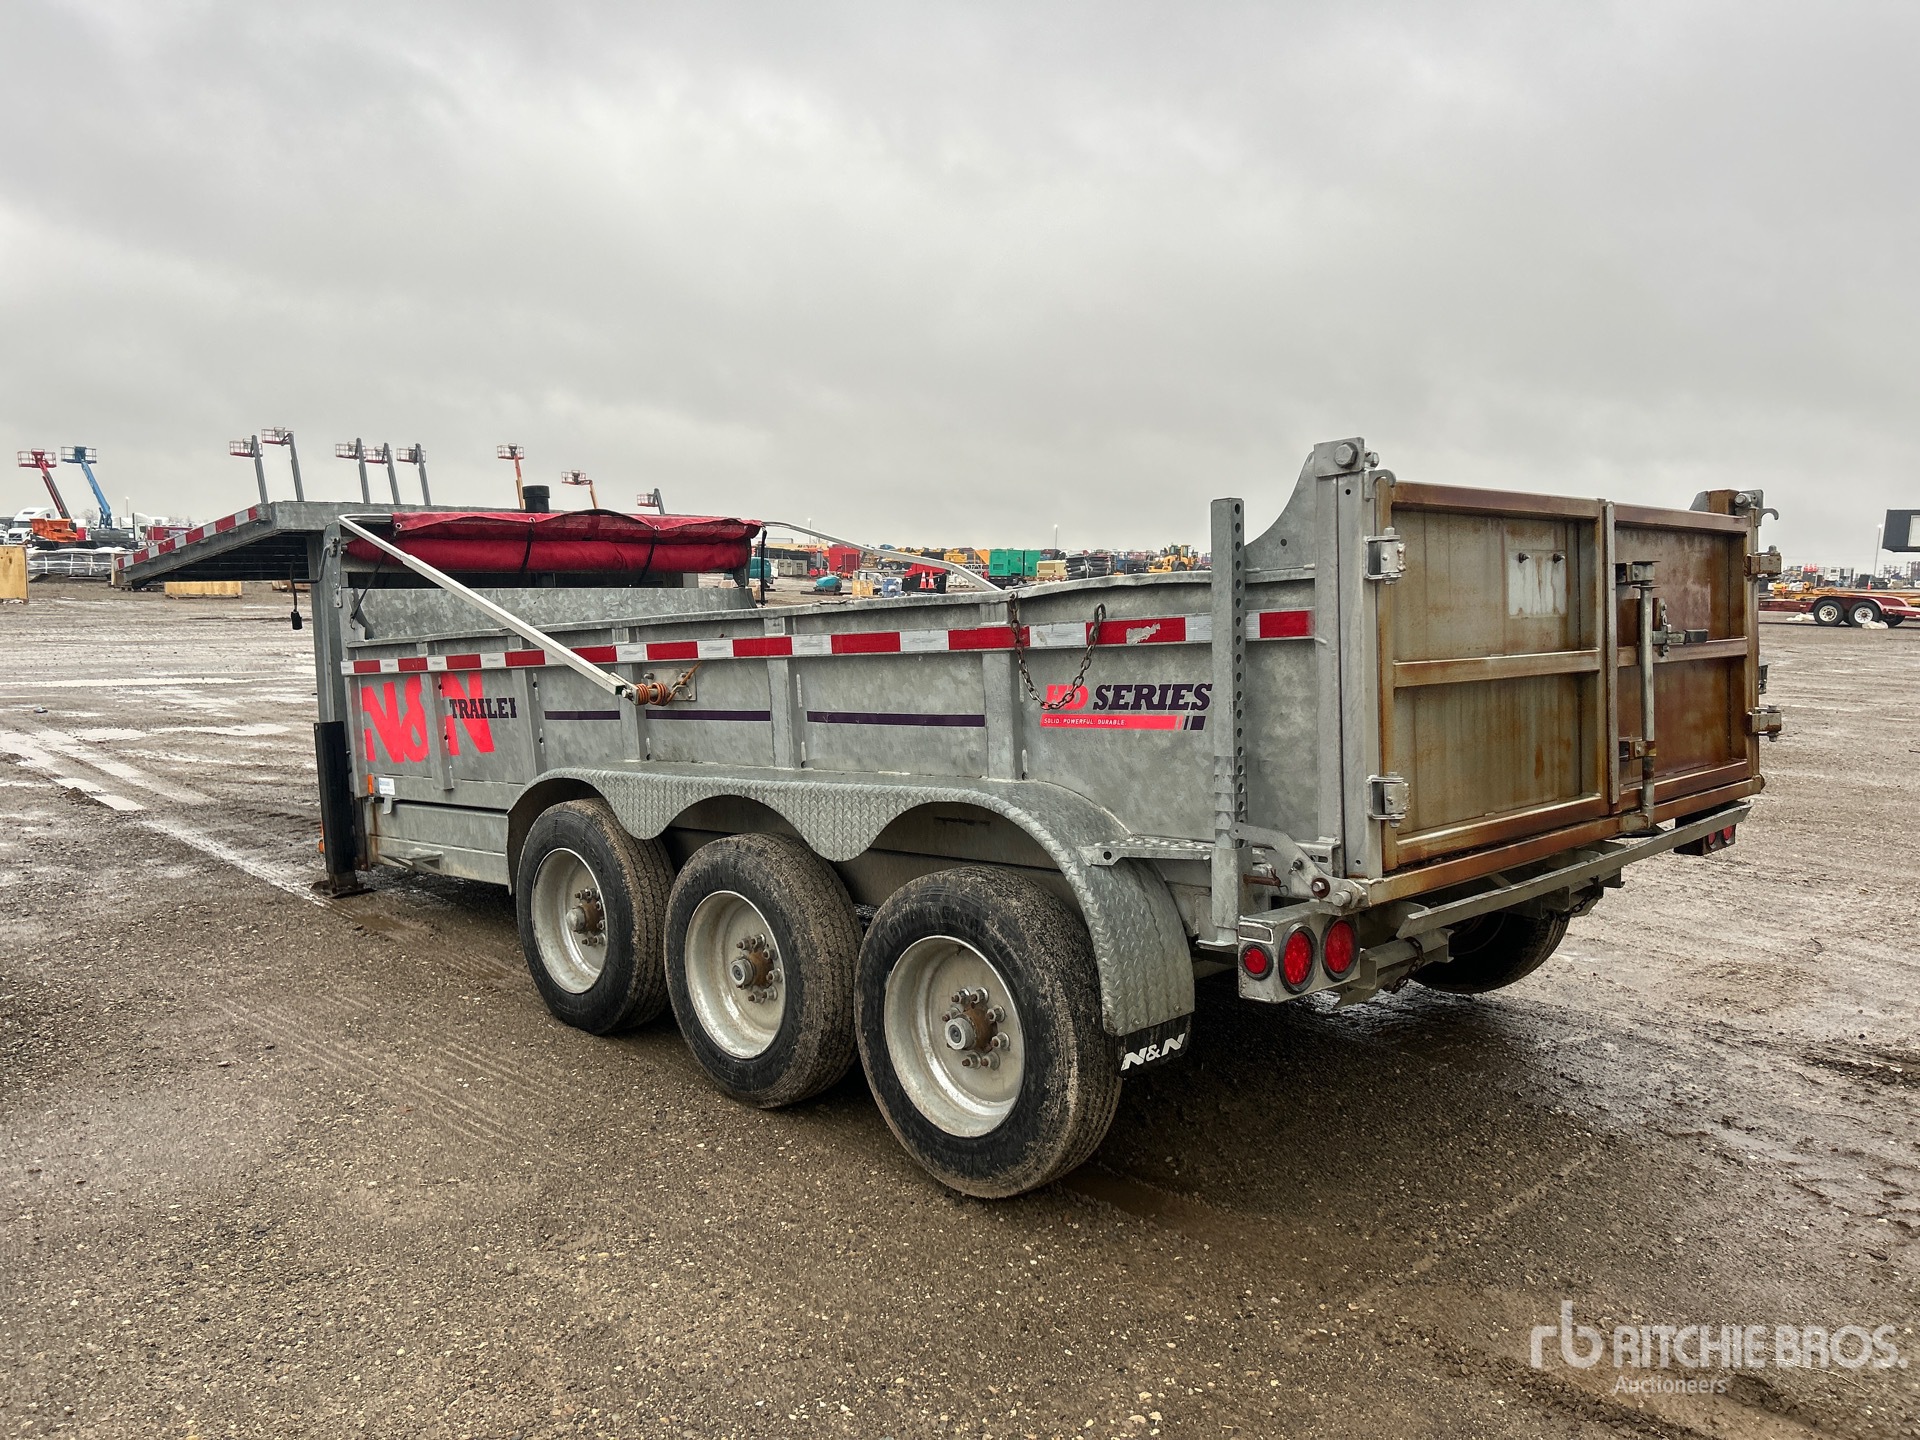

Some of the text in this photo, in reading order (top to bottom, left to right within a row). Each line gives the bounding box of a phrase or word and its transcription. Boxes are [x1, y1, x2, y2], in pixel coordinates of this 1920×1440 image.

[1043, 683, 1213, 711] HD SERIES
[1120, 1033, 1186, 1072] N&N
